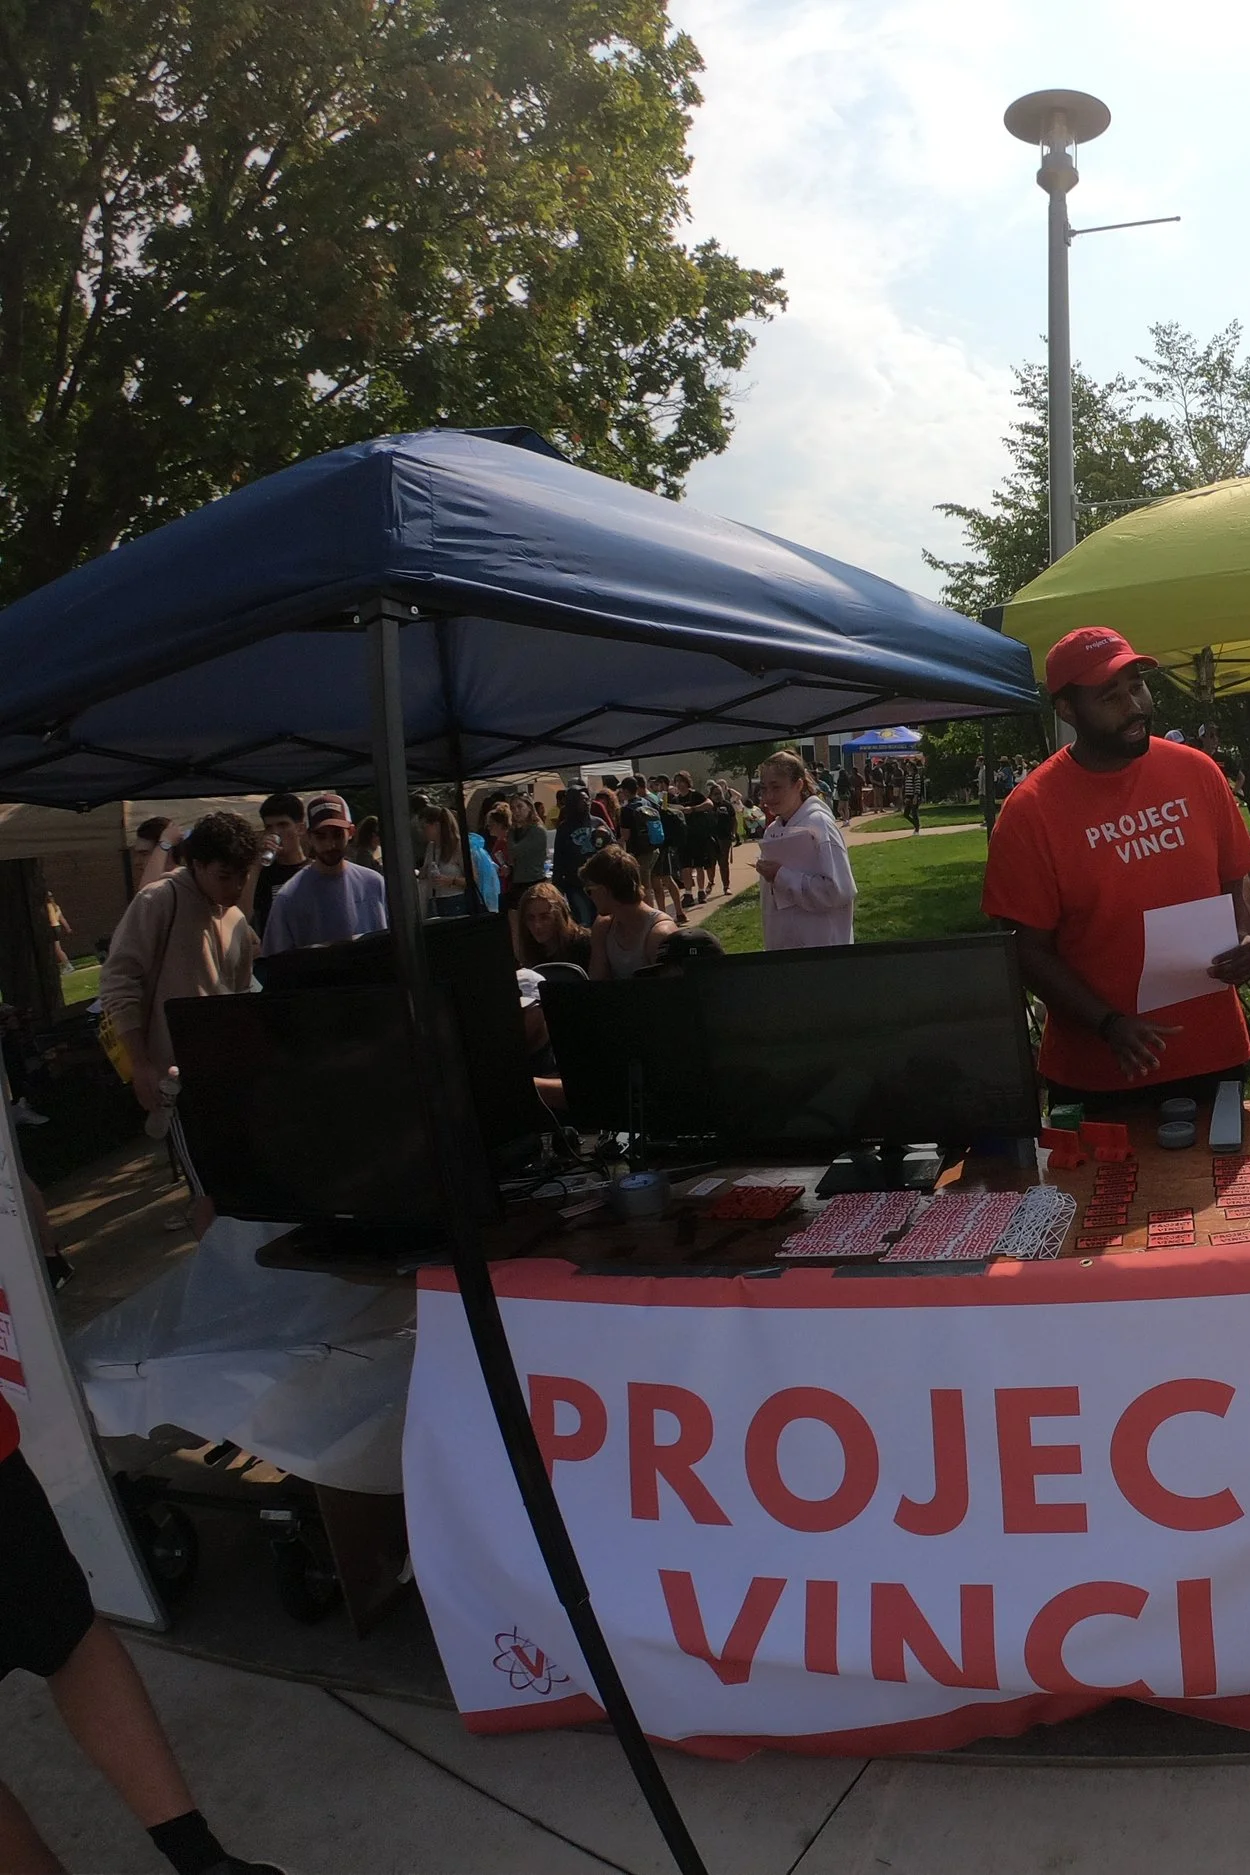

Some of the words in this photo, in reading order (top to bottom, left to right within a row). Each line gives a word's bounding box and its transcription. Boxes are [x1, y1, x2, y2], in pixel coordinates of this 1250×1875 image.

[1085, 798, 1189, 849] PROJECT
[1115, 826, 1185, 864] VINCI
[658, 1568, 1216, 1697] VINCI
